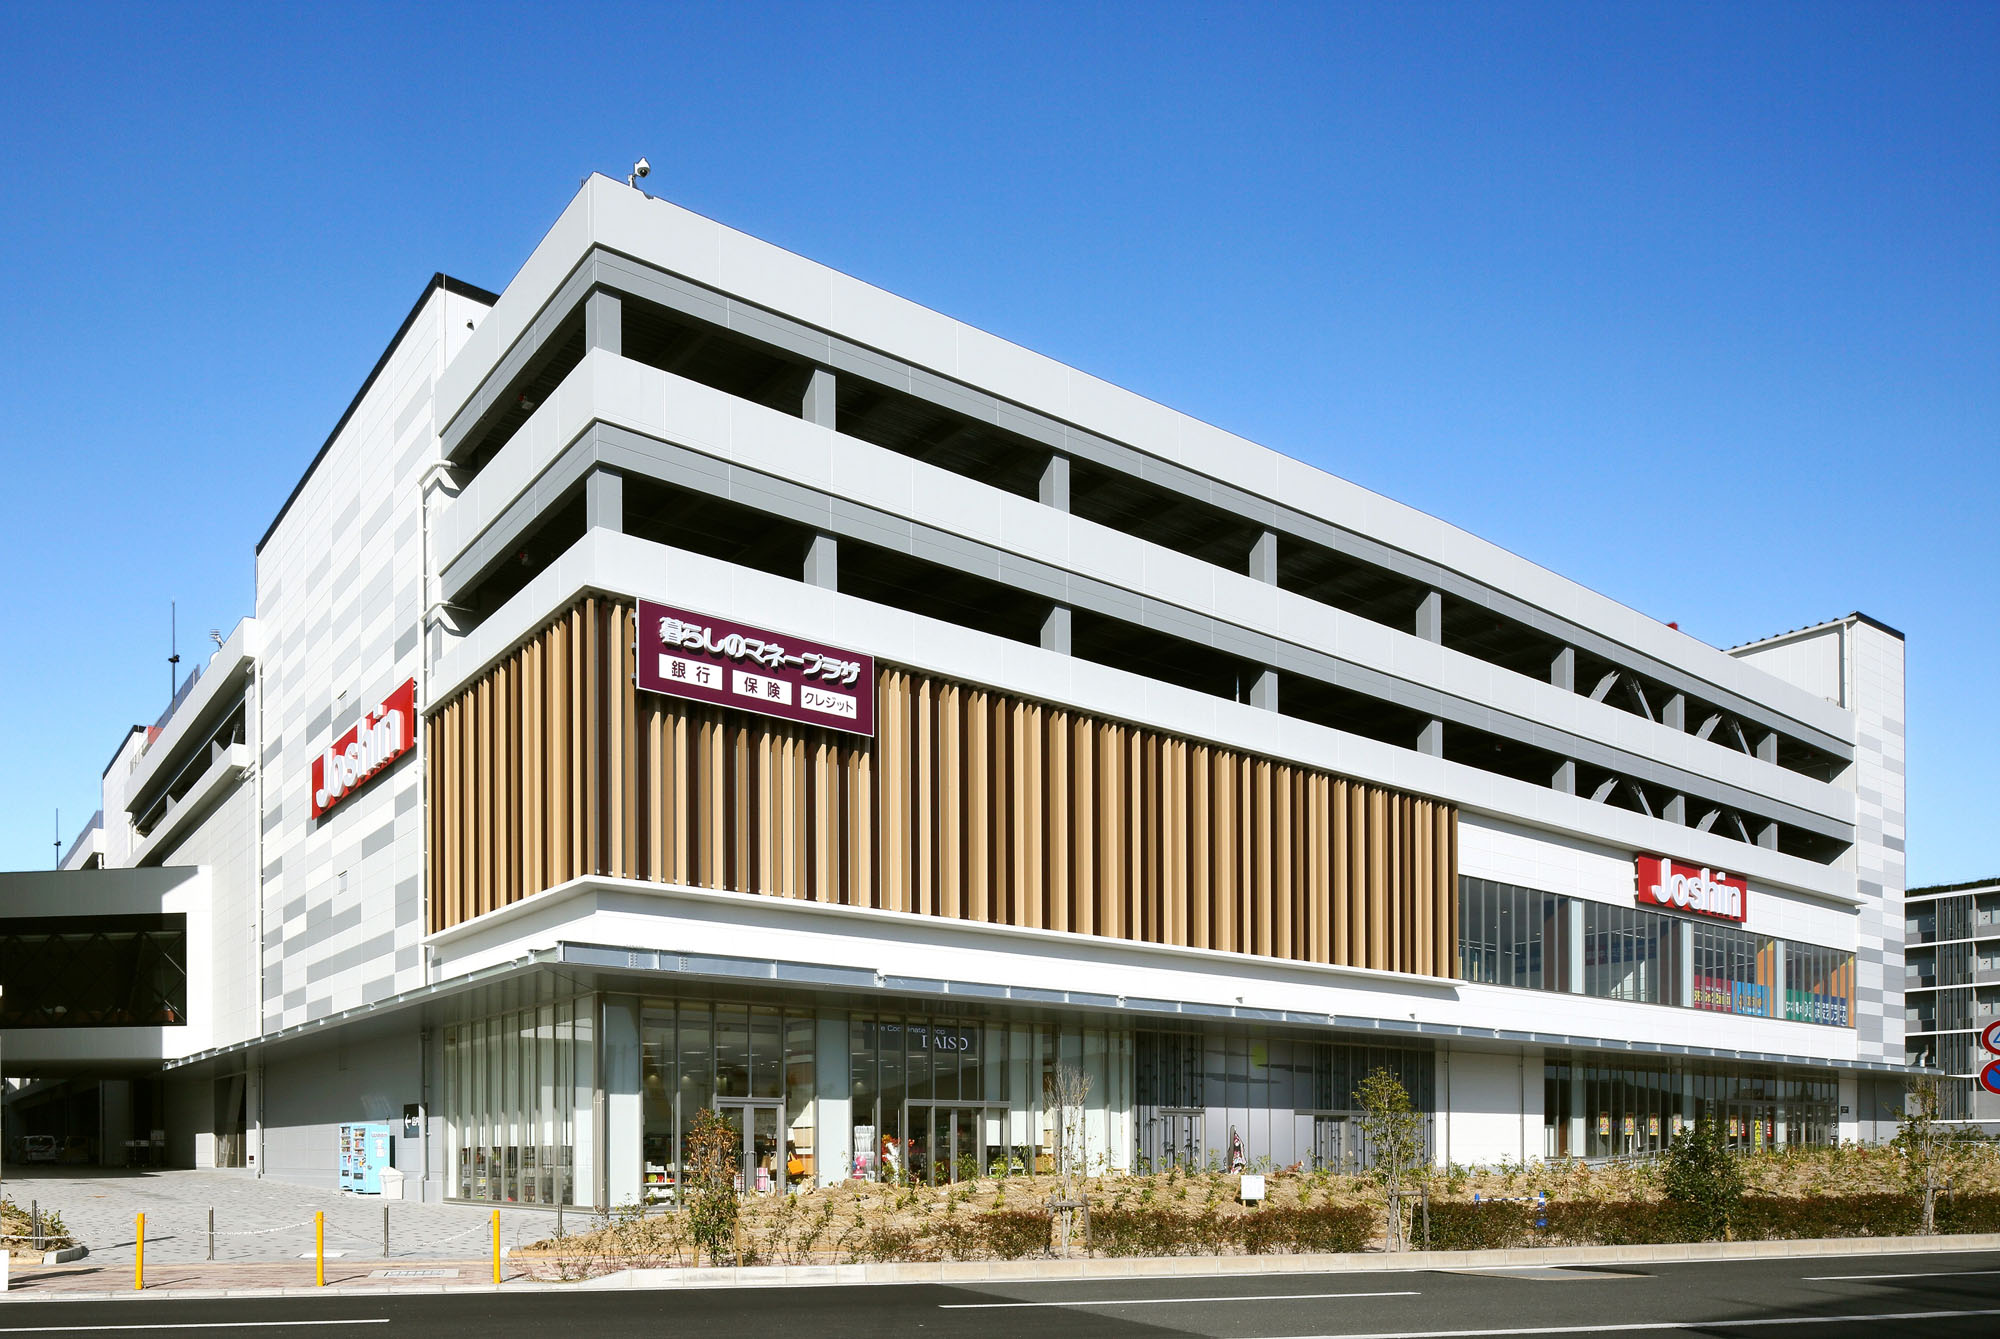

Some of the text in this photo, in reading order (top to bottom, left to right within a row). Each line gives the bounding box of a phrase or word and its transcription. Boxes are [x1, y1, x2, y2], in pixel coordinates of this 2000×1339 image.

[659, 617, 860, 684] 暮らしのマネープラザ
[804, 691, 854, 712] クレジット
[316, 703, 404, 808] Joshin
[1651, 858, 1741, 917] Joshin
